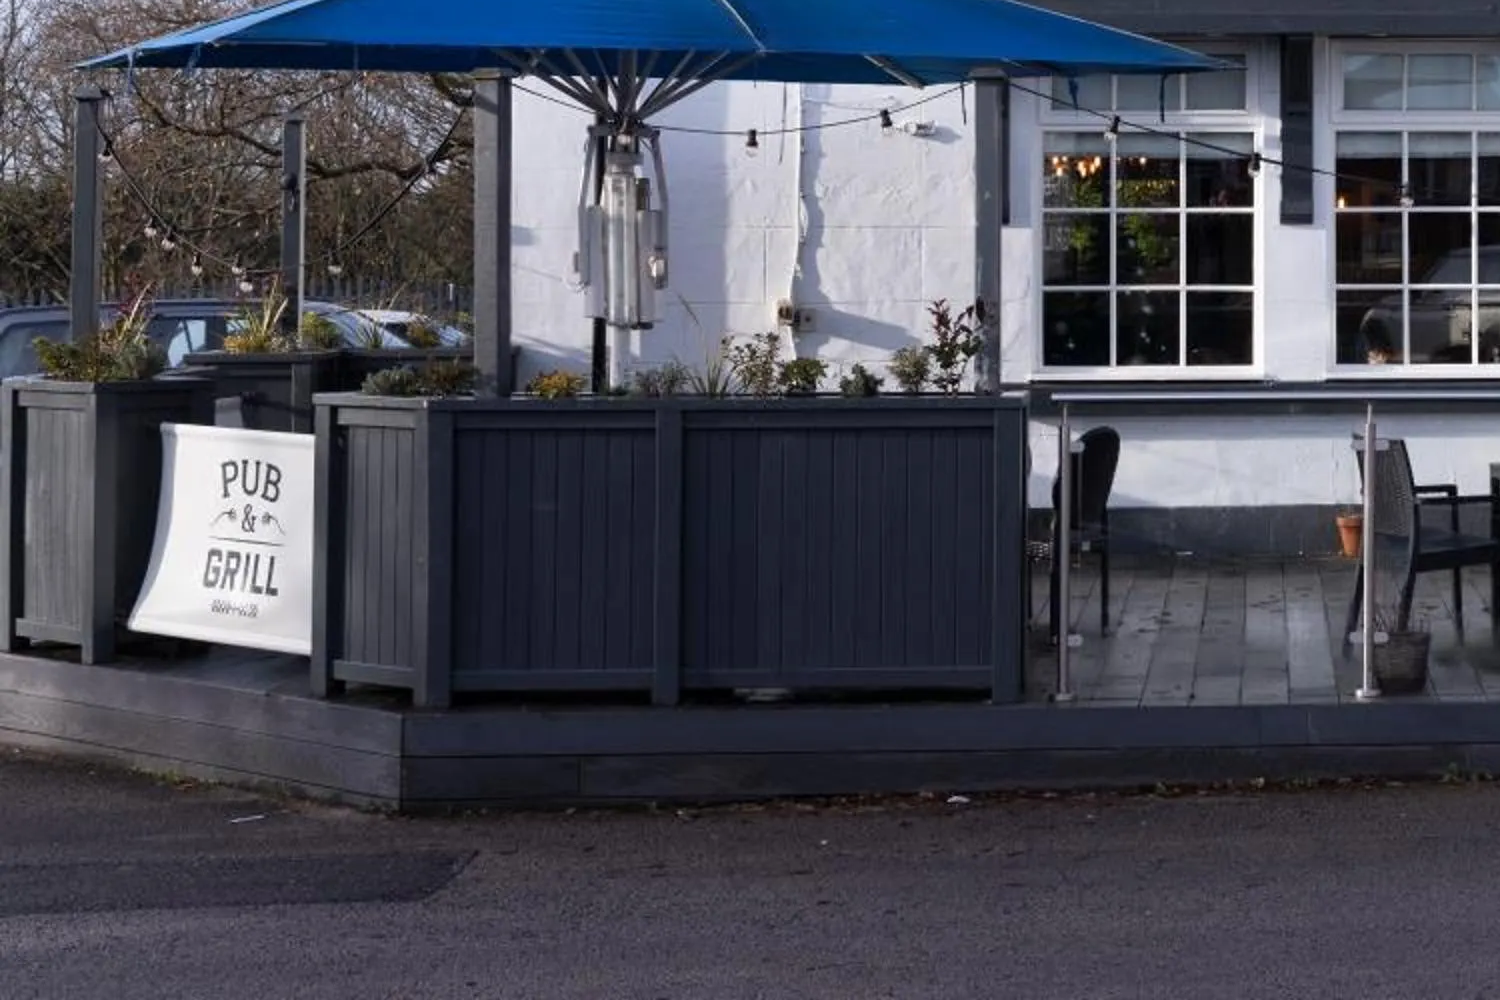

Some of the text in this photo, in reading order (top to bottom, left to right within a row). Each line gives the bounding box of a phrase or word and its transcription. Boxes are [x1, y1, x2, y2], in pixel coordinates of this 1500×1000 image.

[221, 459, 282, 502] PUB
[241, 503, 256, 532] &
[202, 548, 279, 597] GRILL
